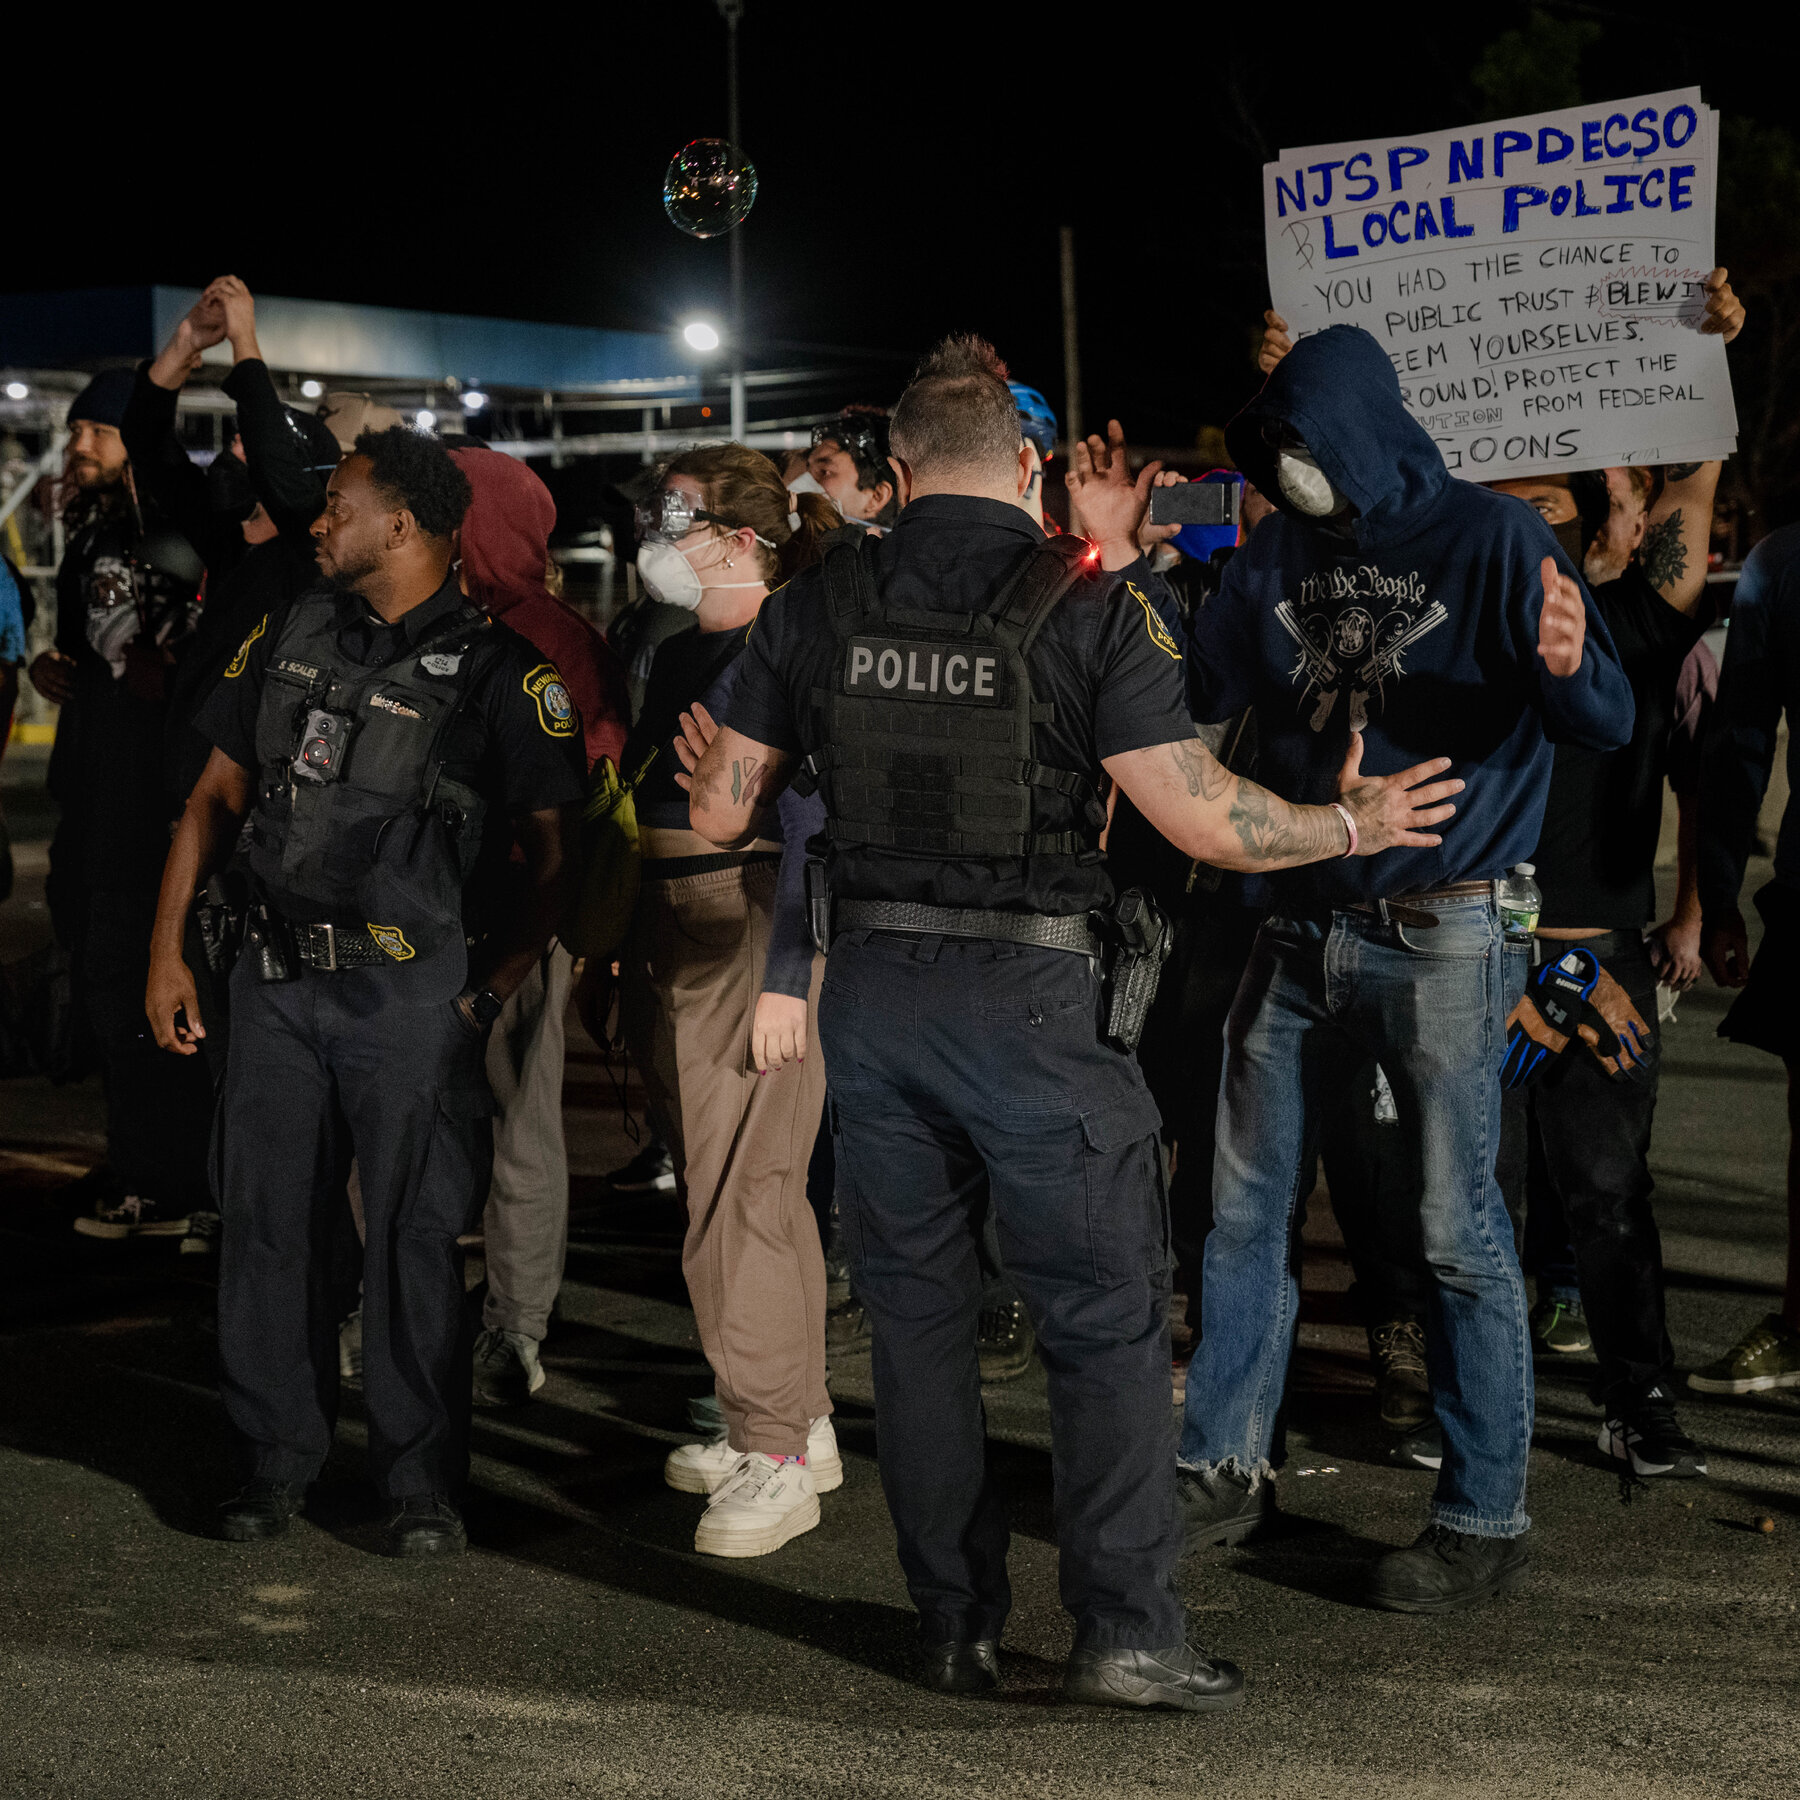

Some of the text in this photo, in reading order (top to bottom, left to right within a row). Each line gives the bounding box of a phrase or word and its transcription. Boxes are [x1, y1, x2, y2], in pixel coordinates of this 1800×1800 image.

[1323, 196, 1475, 259] LOCAL
[1503, 165, 1696, 233] POLICE
[1314, 242, 1680, 313] YOU HAD THE CHANCE TO
[1385, 301, 1483, 337] PUBLIC
[1498, 287, 1575, 316] TRUST
[1389, 320, 1644, 375] EEM YOURSELVES.
[1399, 353, 1678, 408] ROUND! PROTECT THE
[1416, 384, 1705, 431] UTION FROM FEDERAL
[1353, 565, 1427, 609] People
[287, 661, 319, 679] SCALES
[849, 646, 996, 698] POLICE
